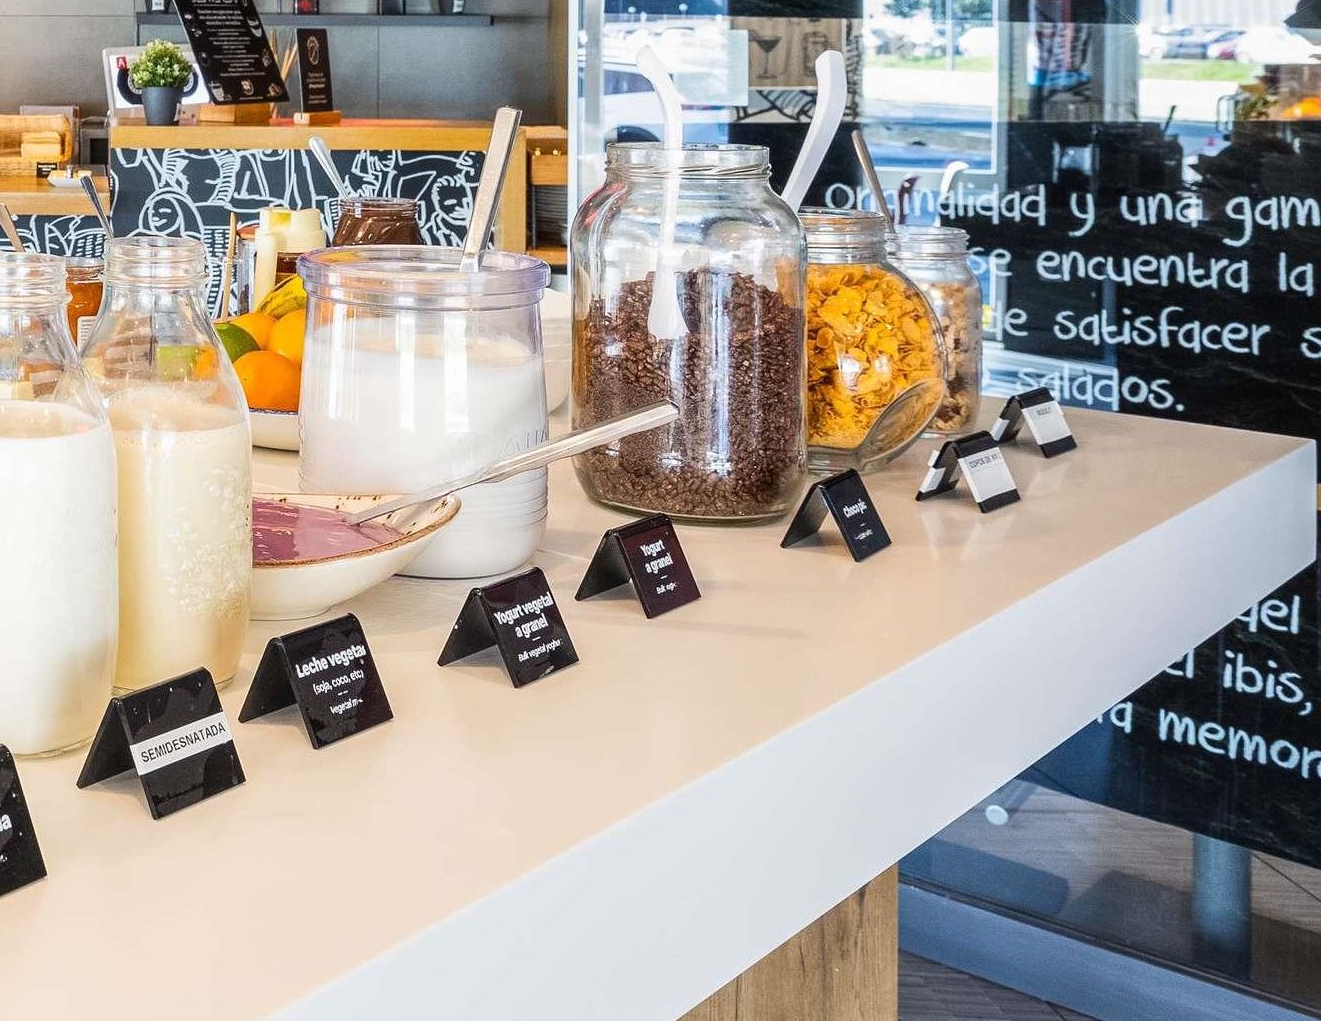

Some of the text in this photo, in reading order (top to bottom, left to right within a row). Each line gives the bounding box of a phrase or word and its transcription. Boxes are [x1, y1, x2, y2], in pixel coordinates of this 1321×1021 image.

[1070, 193, 1096, 237] y
[1121, 193, 1204, 228] una
[1037, 250, 1250, 294] encuentra
[1279, 252, 1316, 297] la
[1054, 306, 1272, 357] satisfacer
[640, 539, 665, 557] Yogurt
[645, 552, 674, 574] a granel
[493, 591, 554, 626] Yogurt vegetal
[515, 613, 549, 639] a granel
[295, 656, 329, 678] Leche
[331, 675, 351, 688] coco,
[349, 669, 365, 681] etc)
[1222, 650, 1313, 717] ibis,
[140, 722, 226, 763] SEMIDESNATADA
[1159, 708, 1321, 780] memor
